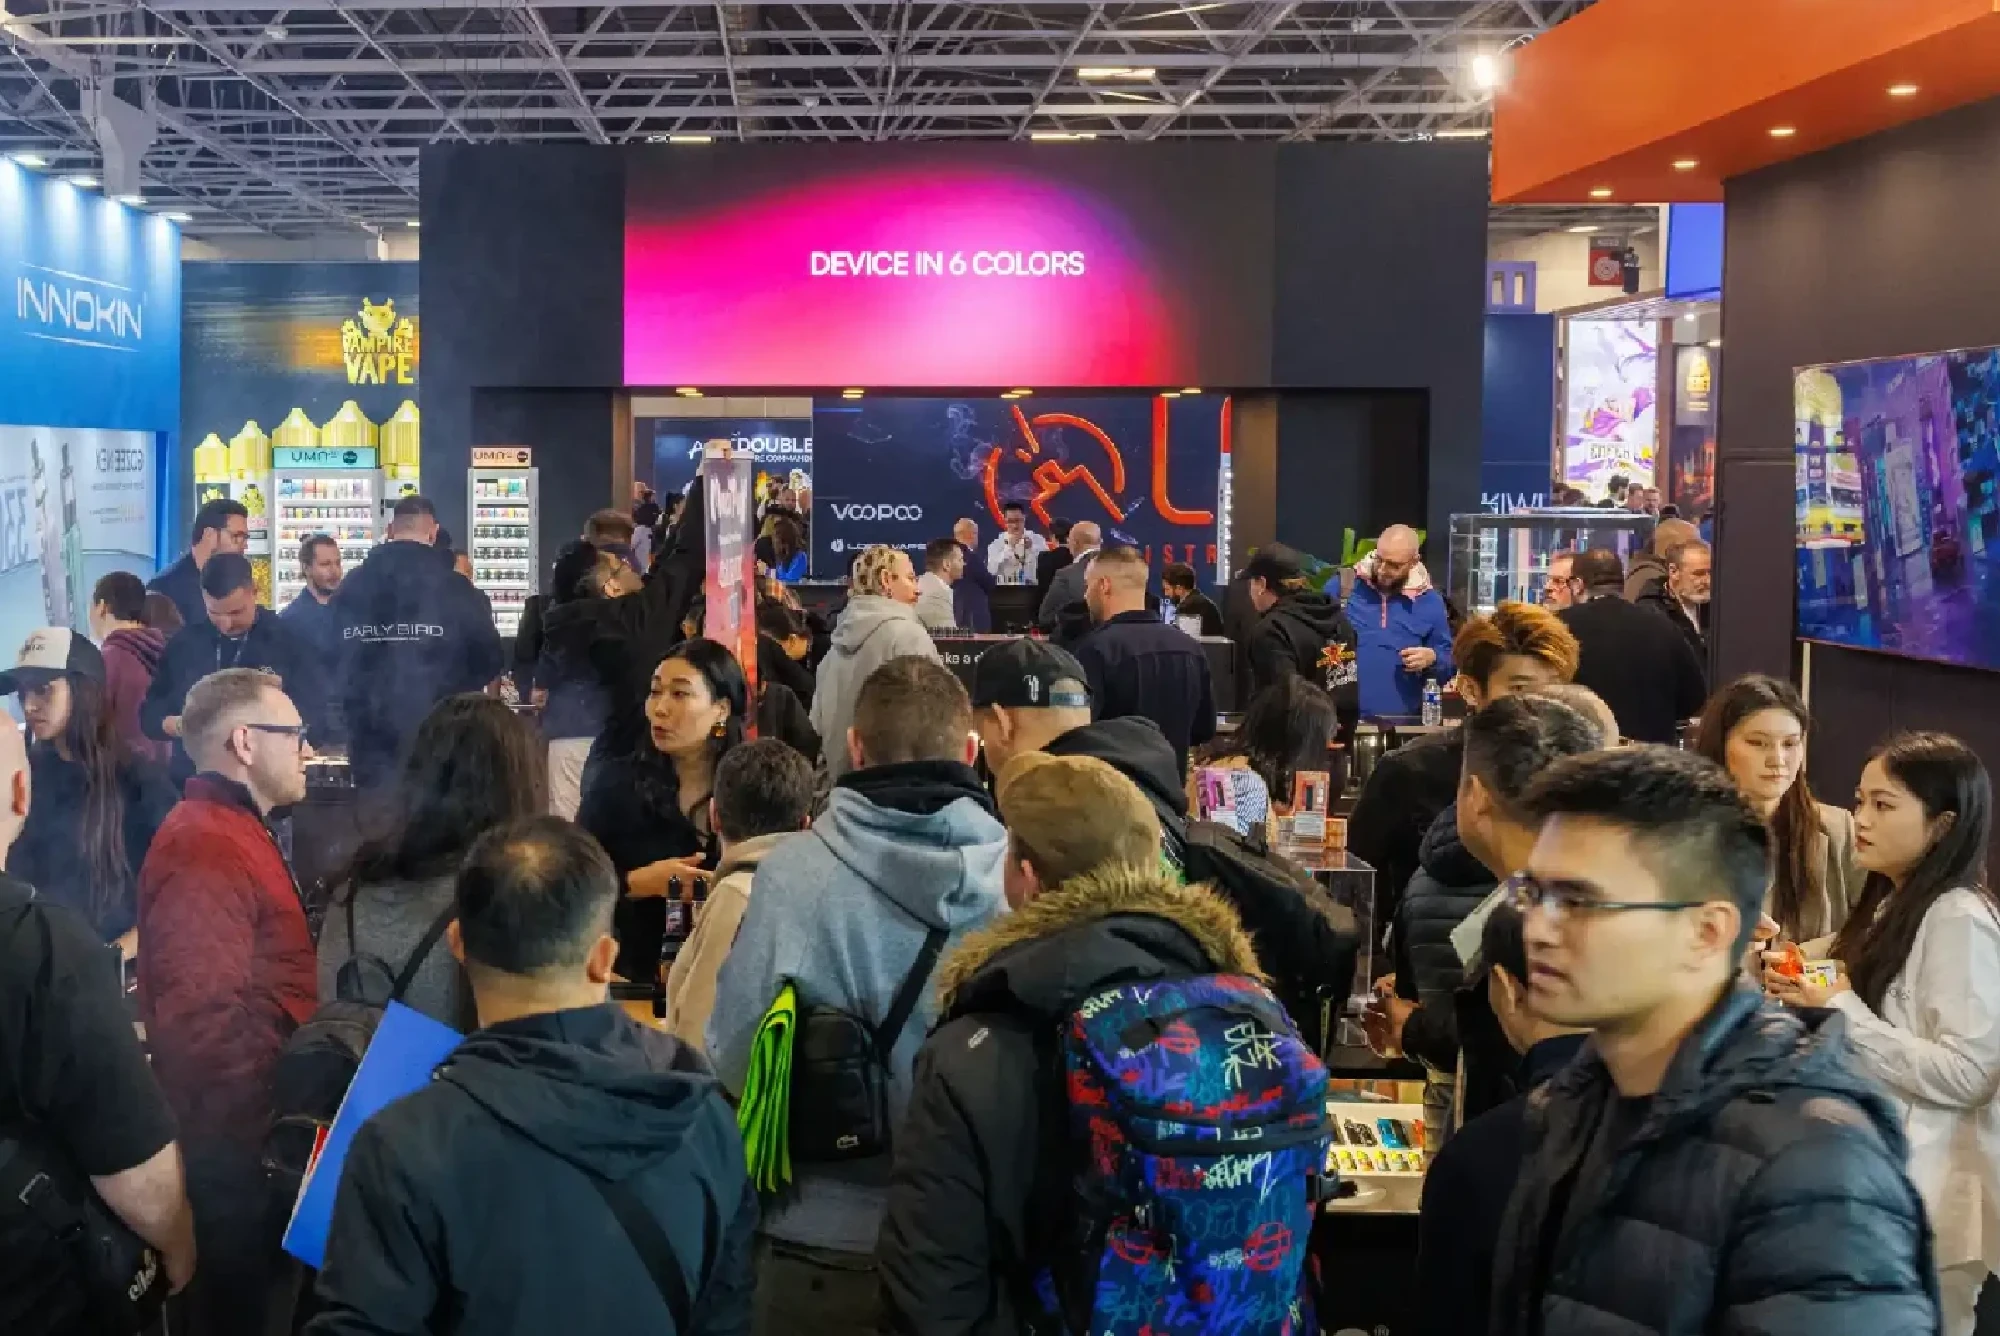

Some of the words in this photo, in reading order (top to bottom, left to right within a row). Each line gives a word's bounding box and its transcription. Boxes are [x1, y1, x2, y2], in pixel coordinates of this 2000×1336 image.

[811, 250, 909, 277] DEVICE
[916, 250, 943, 276] IN
[949, 250, 968, 277] 6
[973, 250, 1085, 277] COLORS
[17, 276, 142, 340] INNOKIN
[342, 333, 414, 353] VAMPIRE
[343, 352, 414, 385] VAPE
[830, 503, 923, 520] VOOPOO
[1481, 492, 1544, 514] KIWI
[1144, 544, 1217, 564] ISTR
[343, 624, 394, 640] EARLY
[398, 623, 444, 637] BIRD
